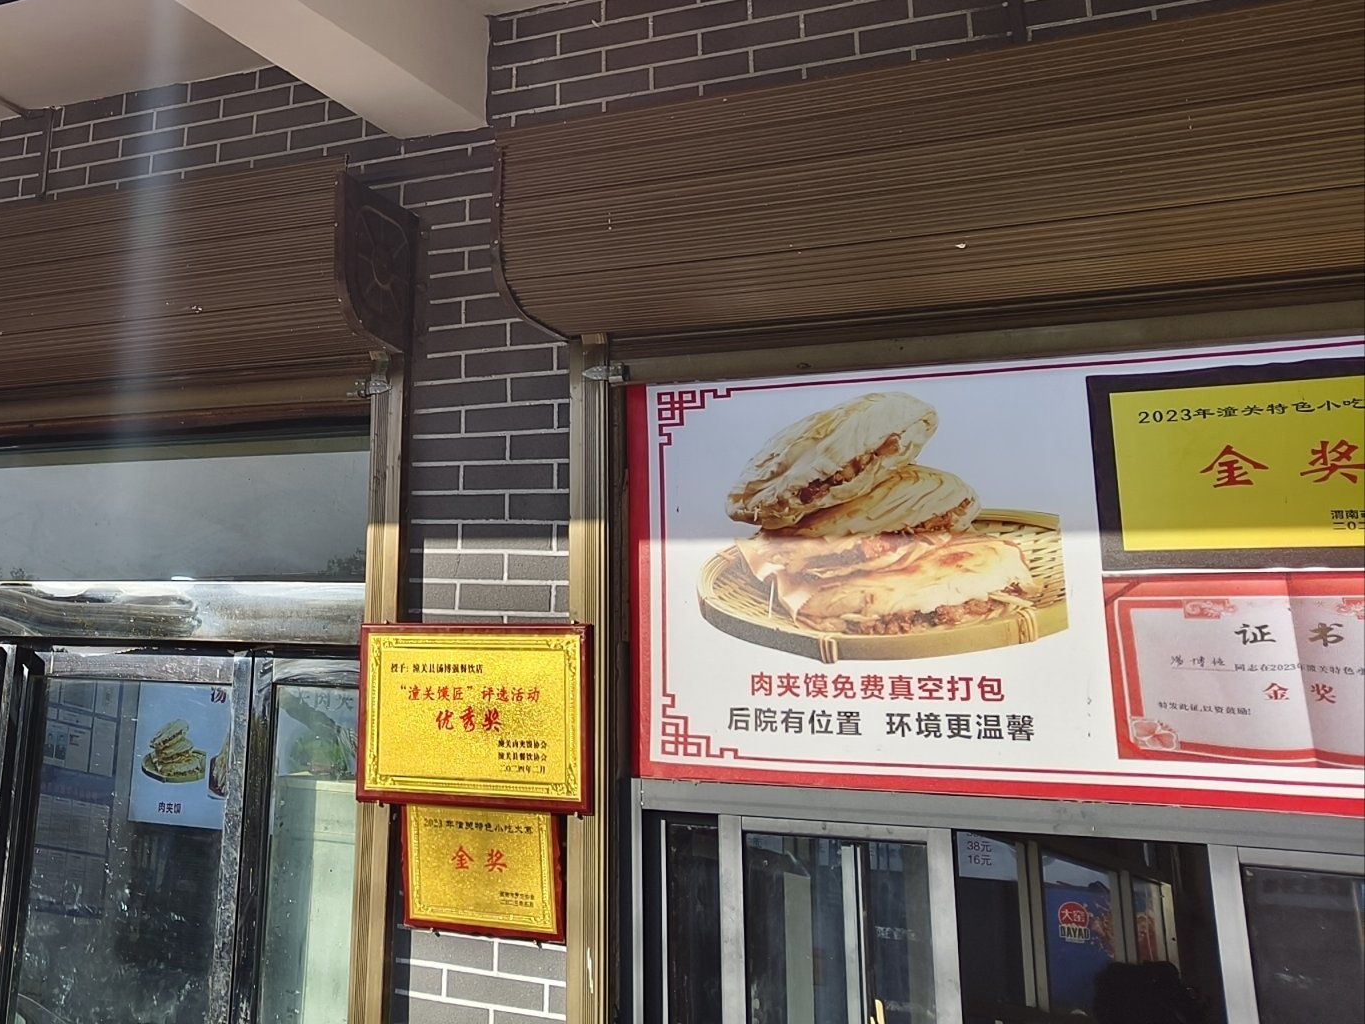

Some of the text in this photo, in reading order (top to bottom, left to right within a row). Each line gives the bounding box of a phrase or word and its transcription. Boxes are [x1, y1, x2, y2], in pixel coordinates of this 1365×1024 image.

[1234, 623, 1345, 647] 证书
[750, 671, 1005, 703] 肉夹馍免费真空打包
[1262, 682, 1338, 704] 金奖
[435, 706, 504, 733] 优秀奖
[727, 707, 1035, 742] 后院有位置 环境更温馨
[157, 800, 183, 815] 肉夹馍
[966, 840, 992, 853] 38元
[451, 844, 508, 874] 金奖
[967, 854, 992, 866] 16元
